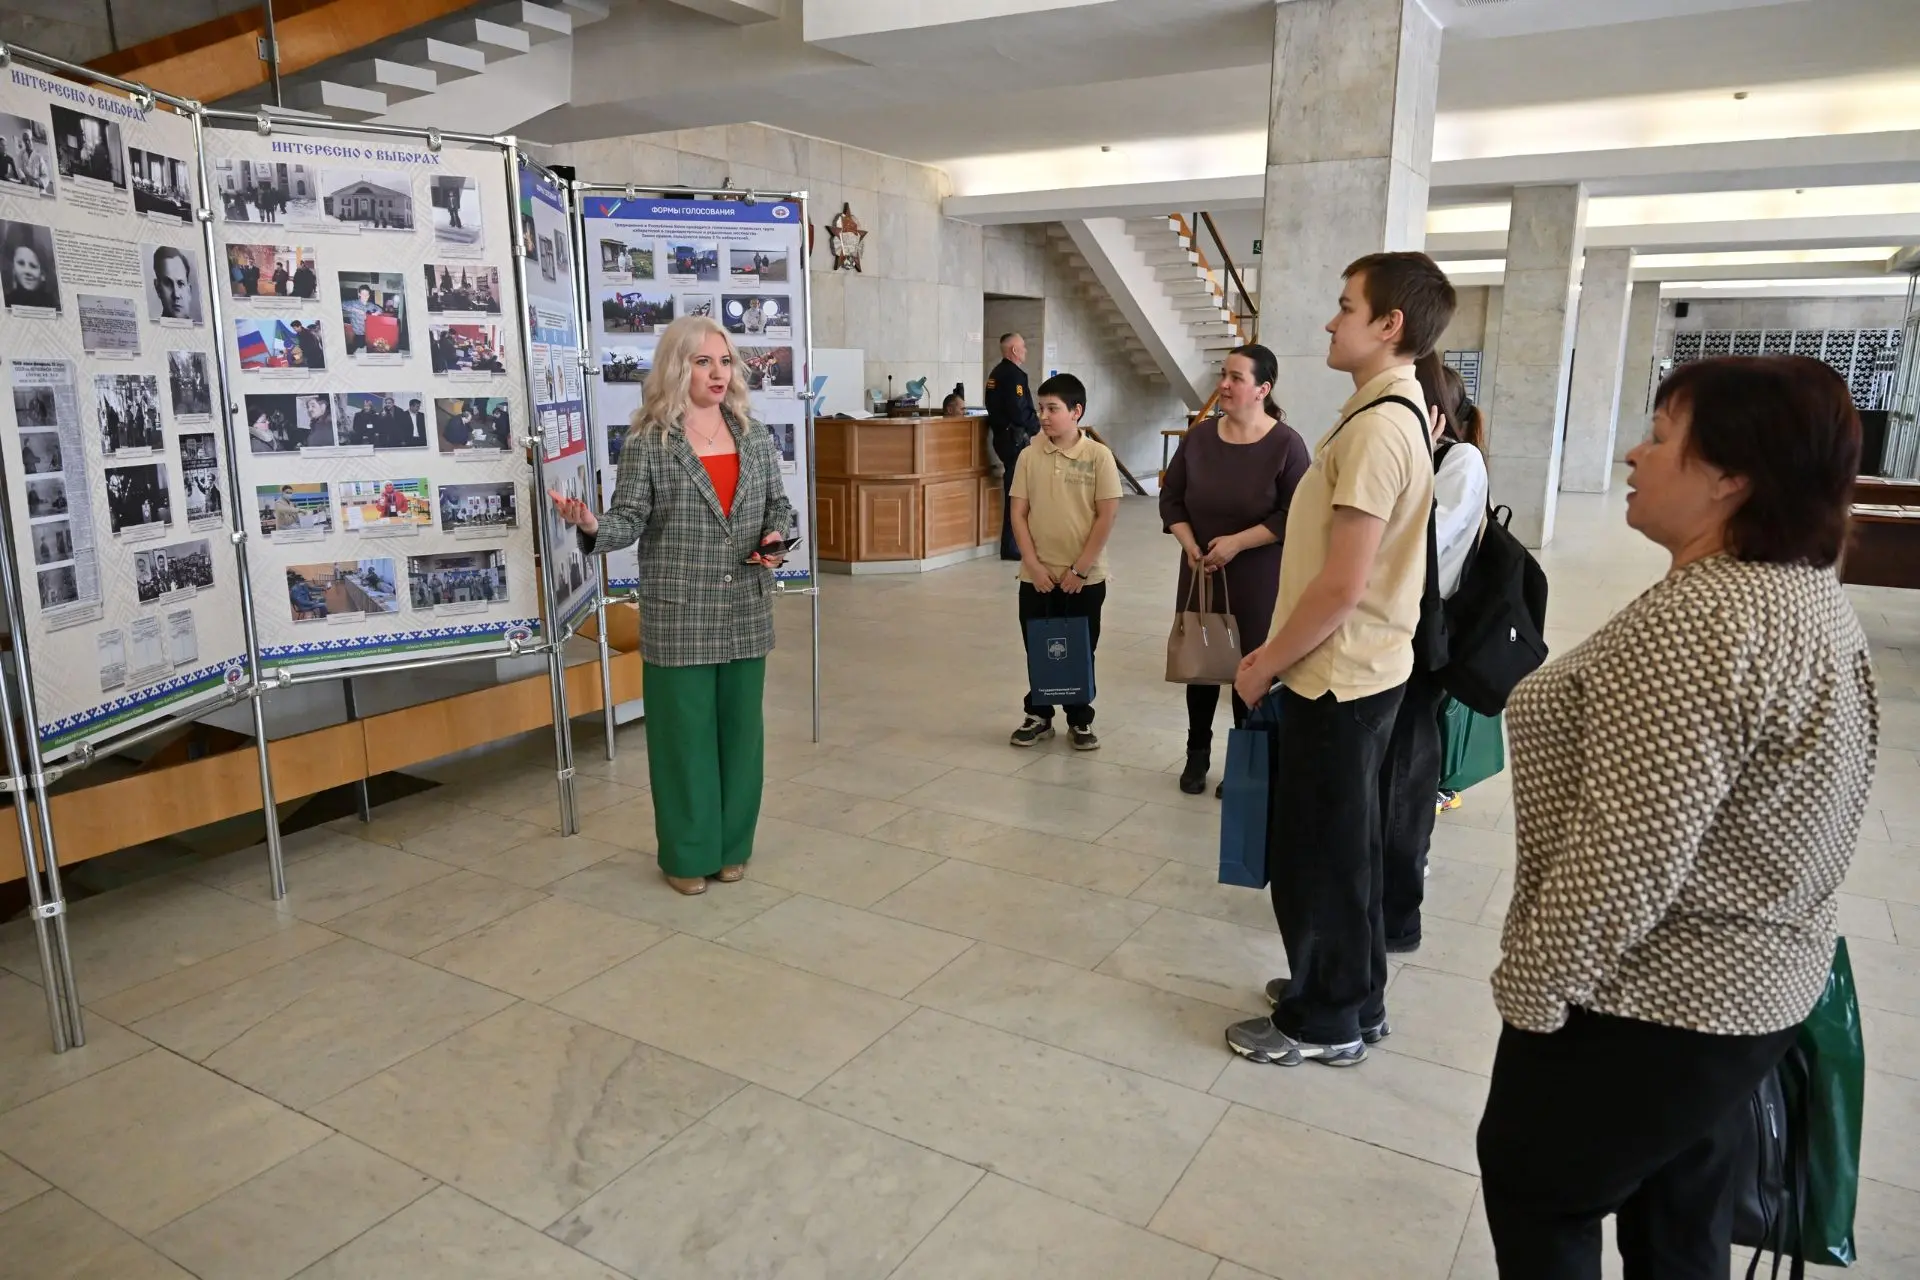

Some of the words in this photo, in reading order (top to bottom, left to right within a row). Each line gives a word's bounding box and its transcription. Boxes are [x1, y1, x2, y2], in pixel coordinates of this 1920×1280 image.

[11, 69, 86, 105] ИНТЕРЕСНО
[88, 92, 96, 106] О
[97, 97, 147, 122] ВЫБОРАХ
[272, 141, 361, 159] ИНТЕРЕСНО
[364, 149, 374, 160] О
[376, 150, 440, 165] ВЫБОРАХ
[651, 206, 681, 214] ФОРМЫ
[681, 207, 736, 216] ГОЛОСОВАНИЯ
